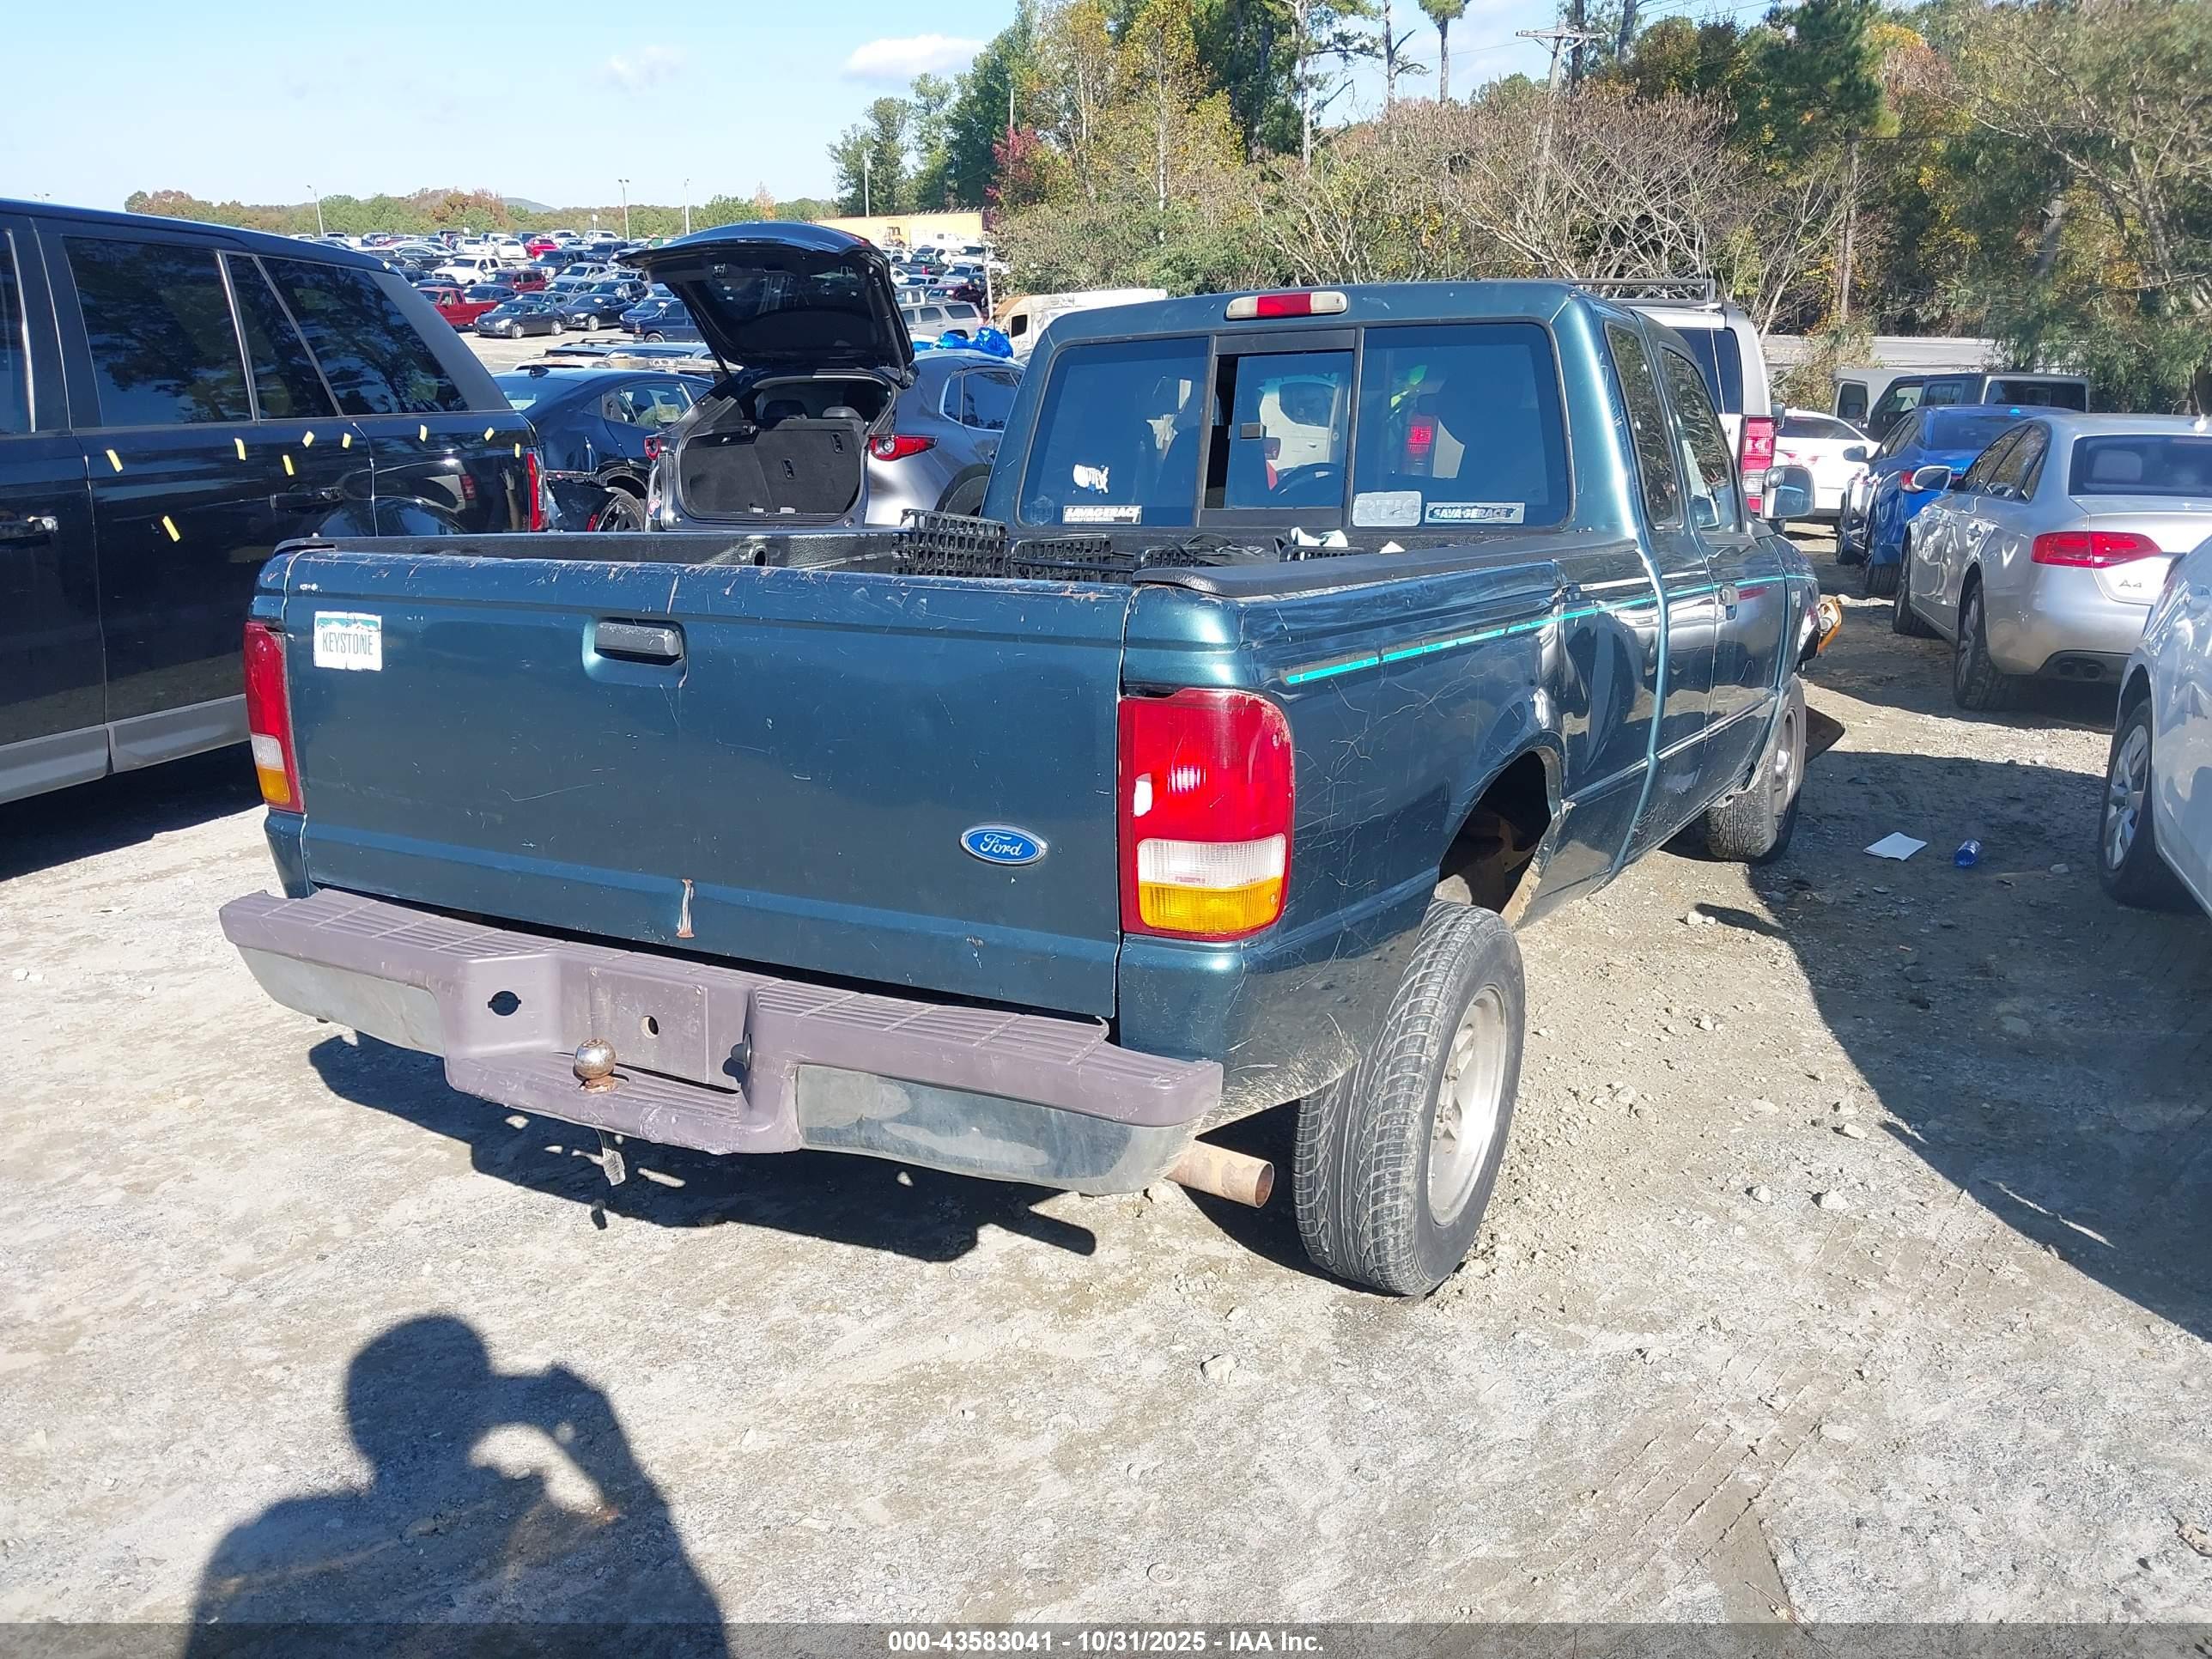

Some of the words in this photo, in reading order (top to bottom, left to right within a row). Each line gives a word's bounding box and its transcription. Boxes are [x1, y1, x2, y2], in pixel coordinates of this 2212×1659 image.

[2118, 579, 2142, 588] A4
[322, 631, 374, 656] KEYSTONE
[980, 833, 1024, 856] Ford
